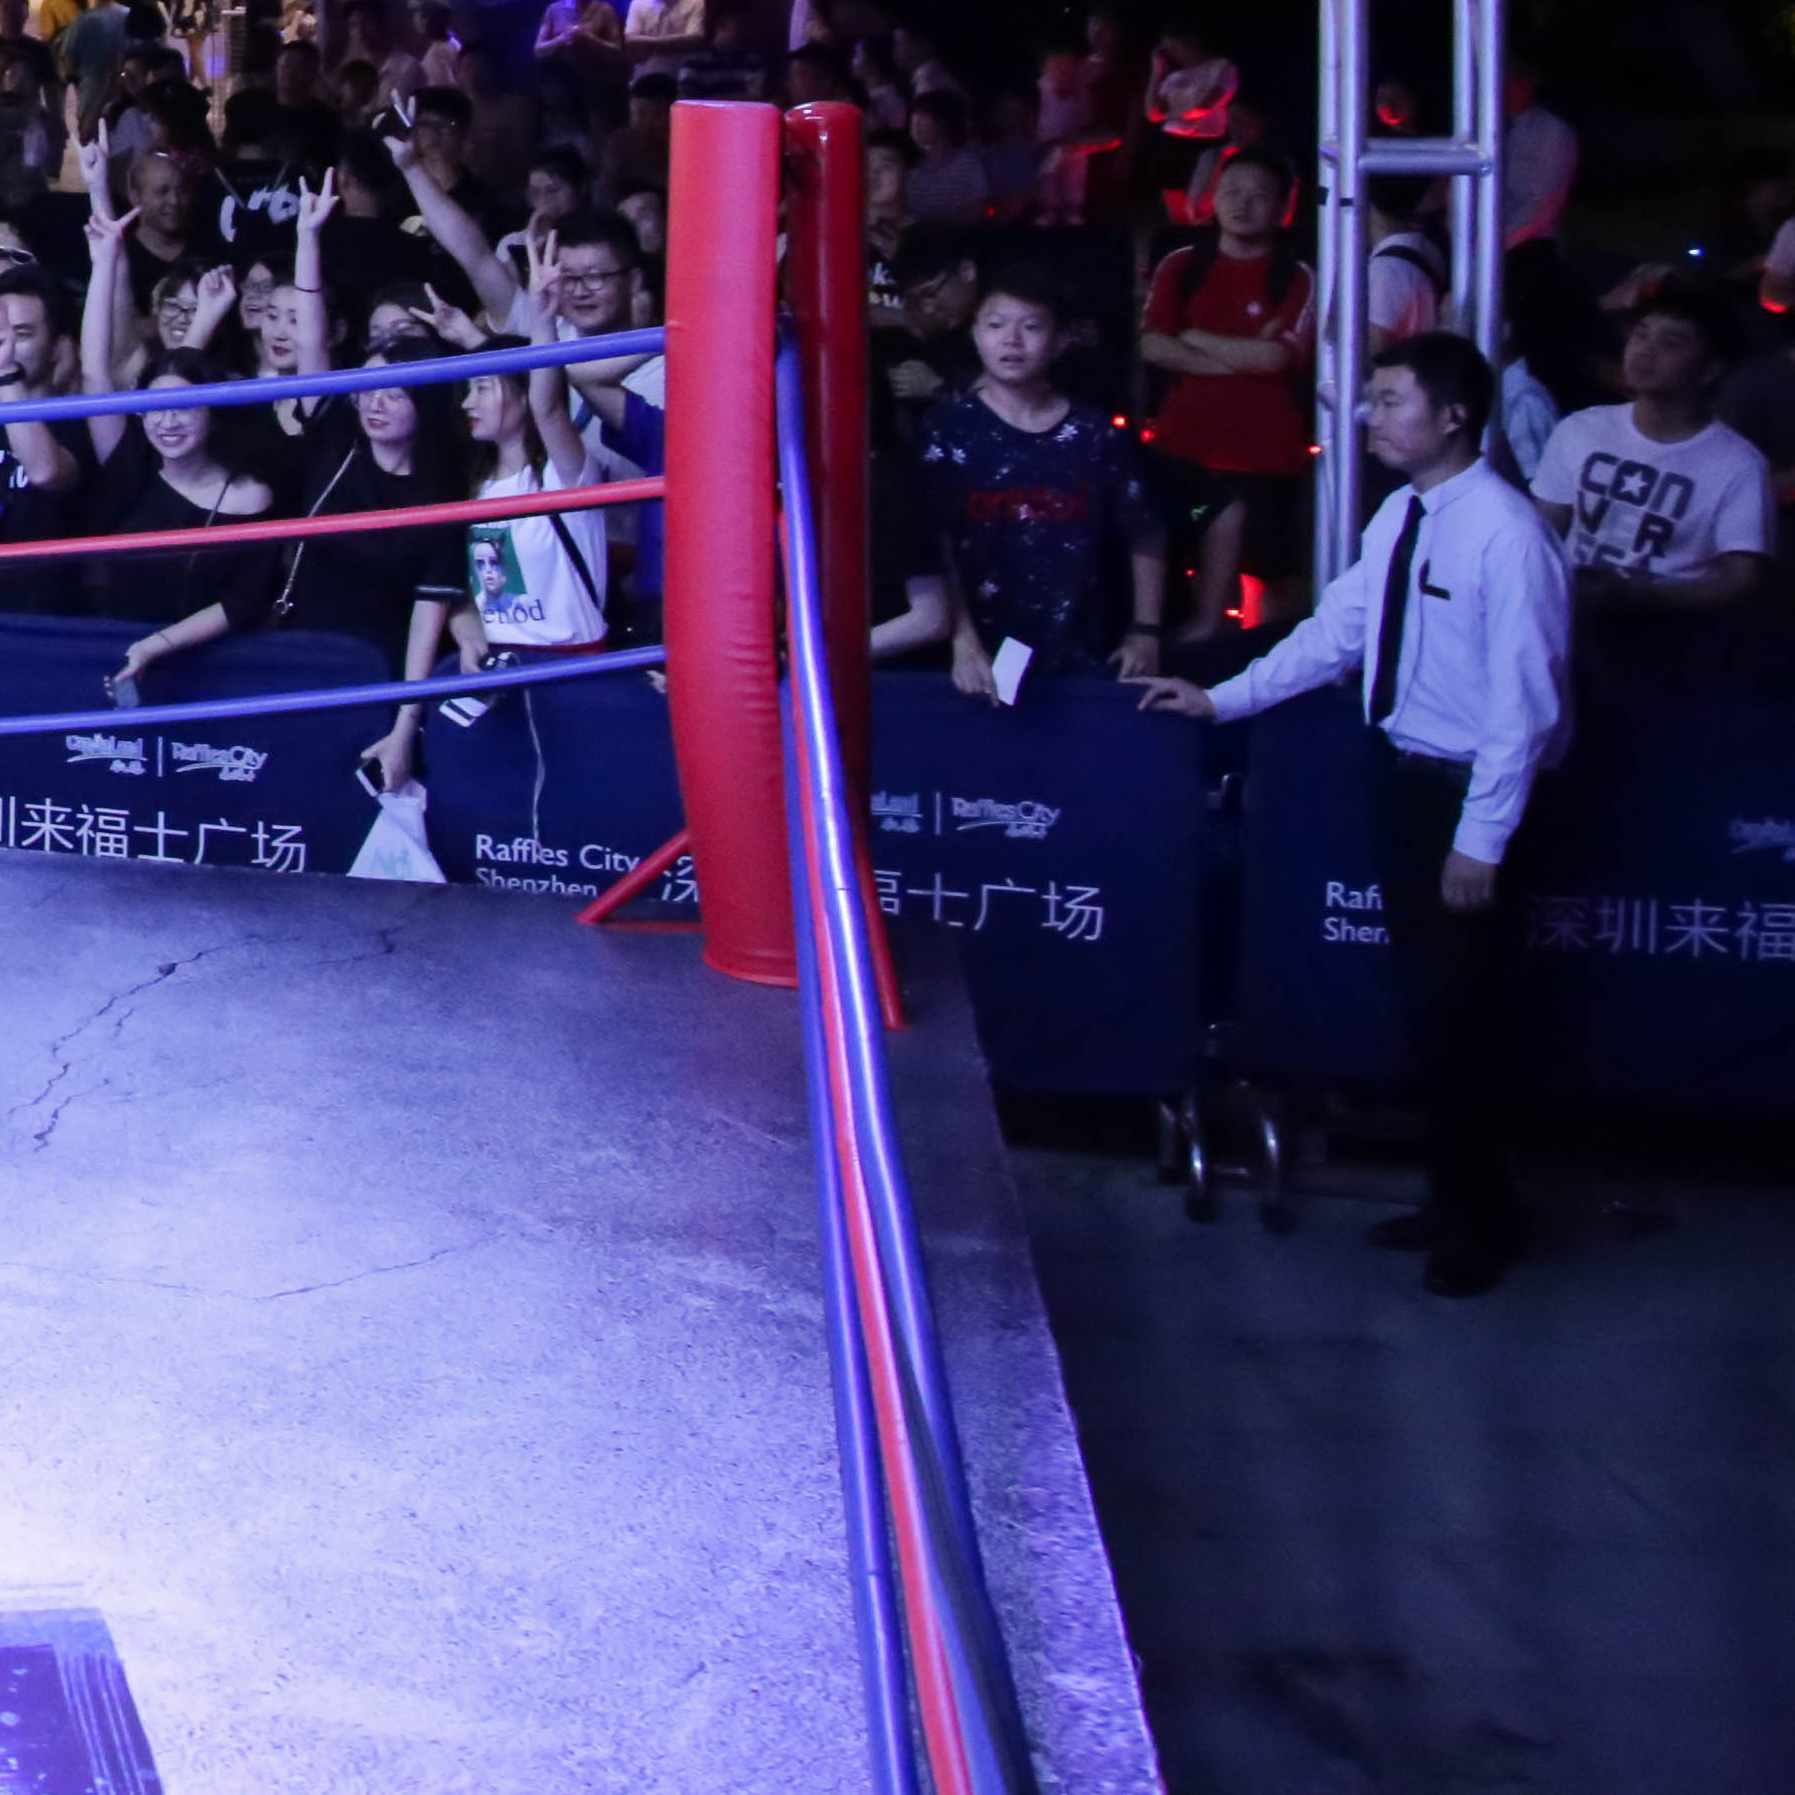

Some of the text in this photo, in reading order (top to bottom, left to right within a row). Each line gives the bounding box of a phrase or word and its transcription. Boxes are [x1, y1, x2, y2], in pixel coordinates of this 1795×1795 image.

[475, 834, 641, 872] Raffles City
[475, 867, 598, 897] Shenzhen
